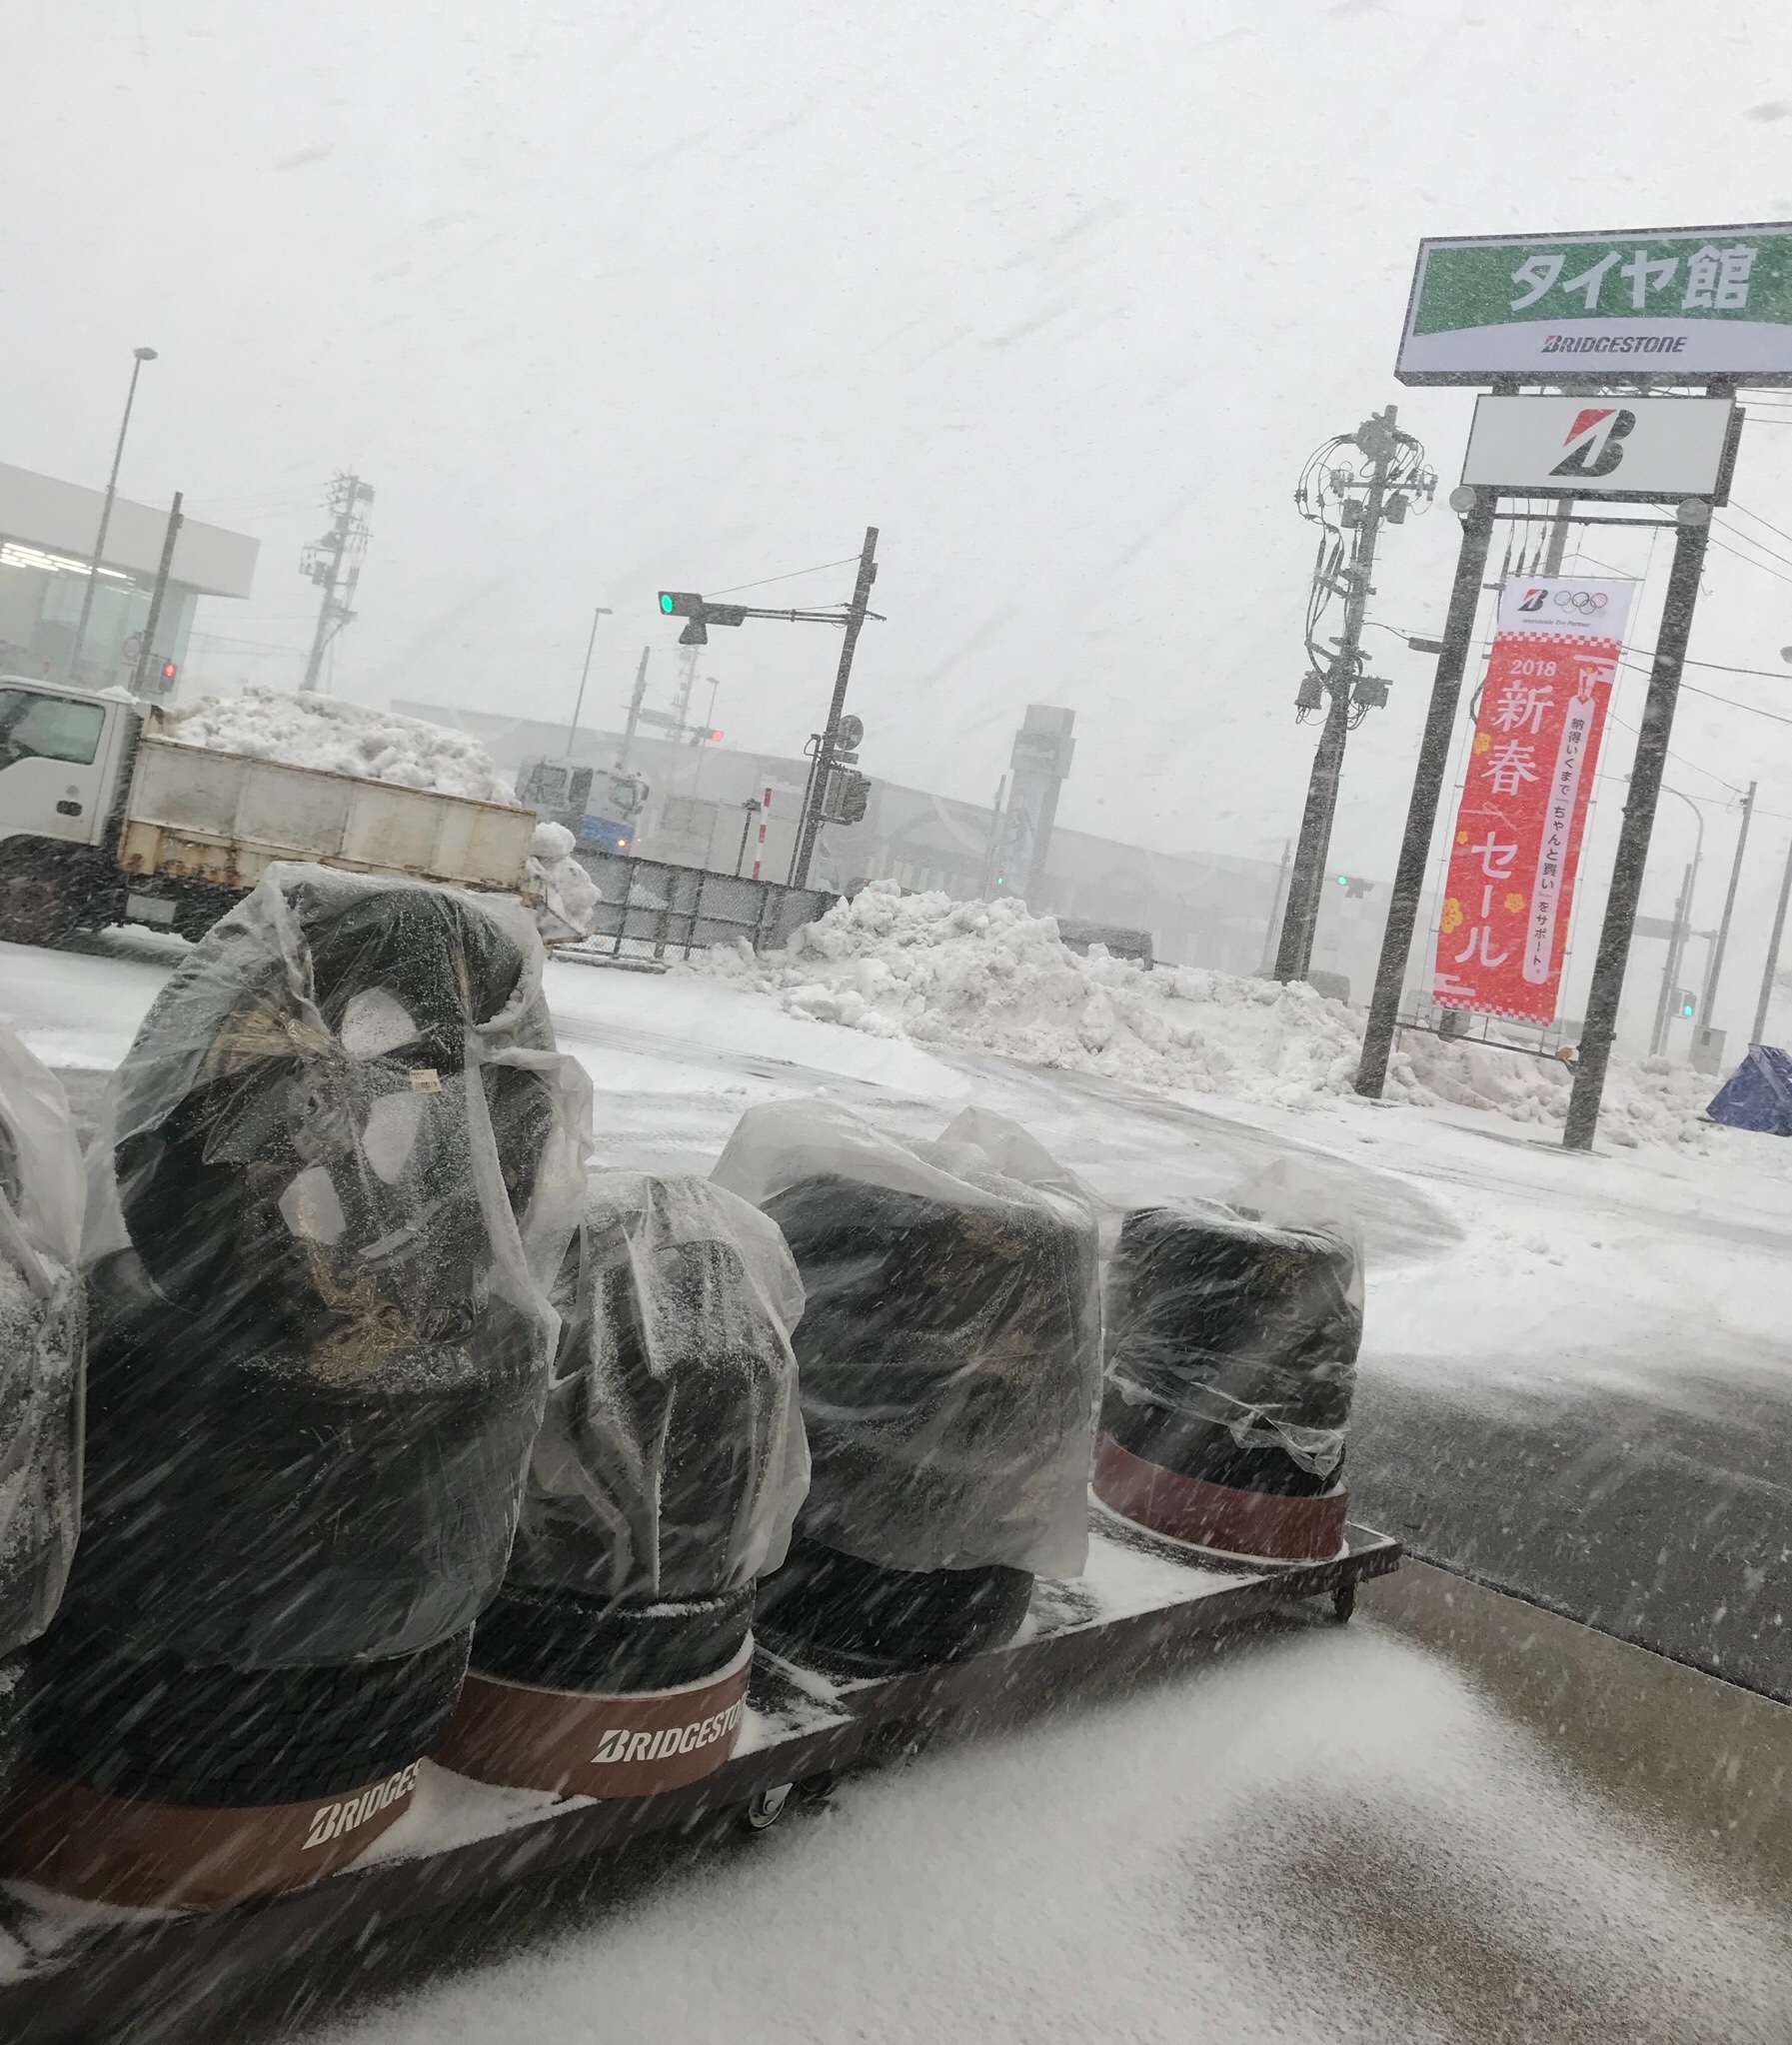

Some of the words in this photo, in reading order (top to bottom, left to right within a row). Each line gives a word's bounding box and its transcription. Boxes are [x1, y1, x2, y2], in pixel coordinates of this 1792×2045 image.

[1509, 243, 1758, 313] タイヤ館
[1540, 335, 1688, 354] BRIDGESTONE
[1509, 659, 1557, 677] 2018
[1454, 679, 1554, 968] 新春セール
[591, 1694, 745, 1763] BRIDGESTO
